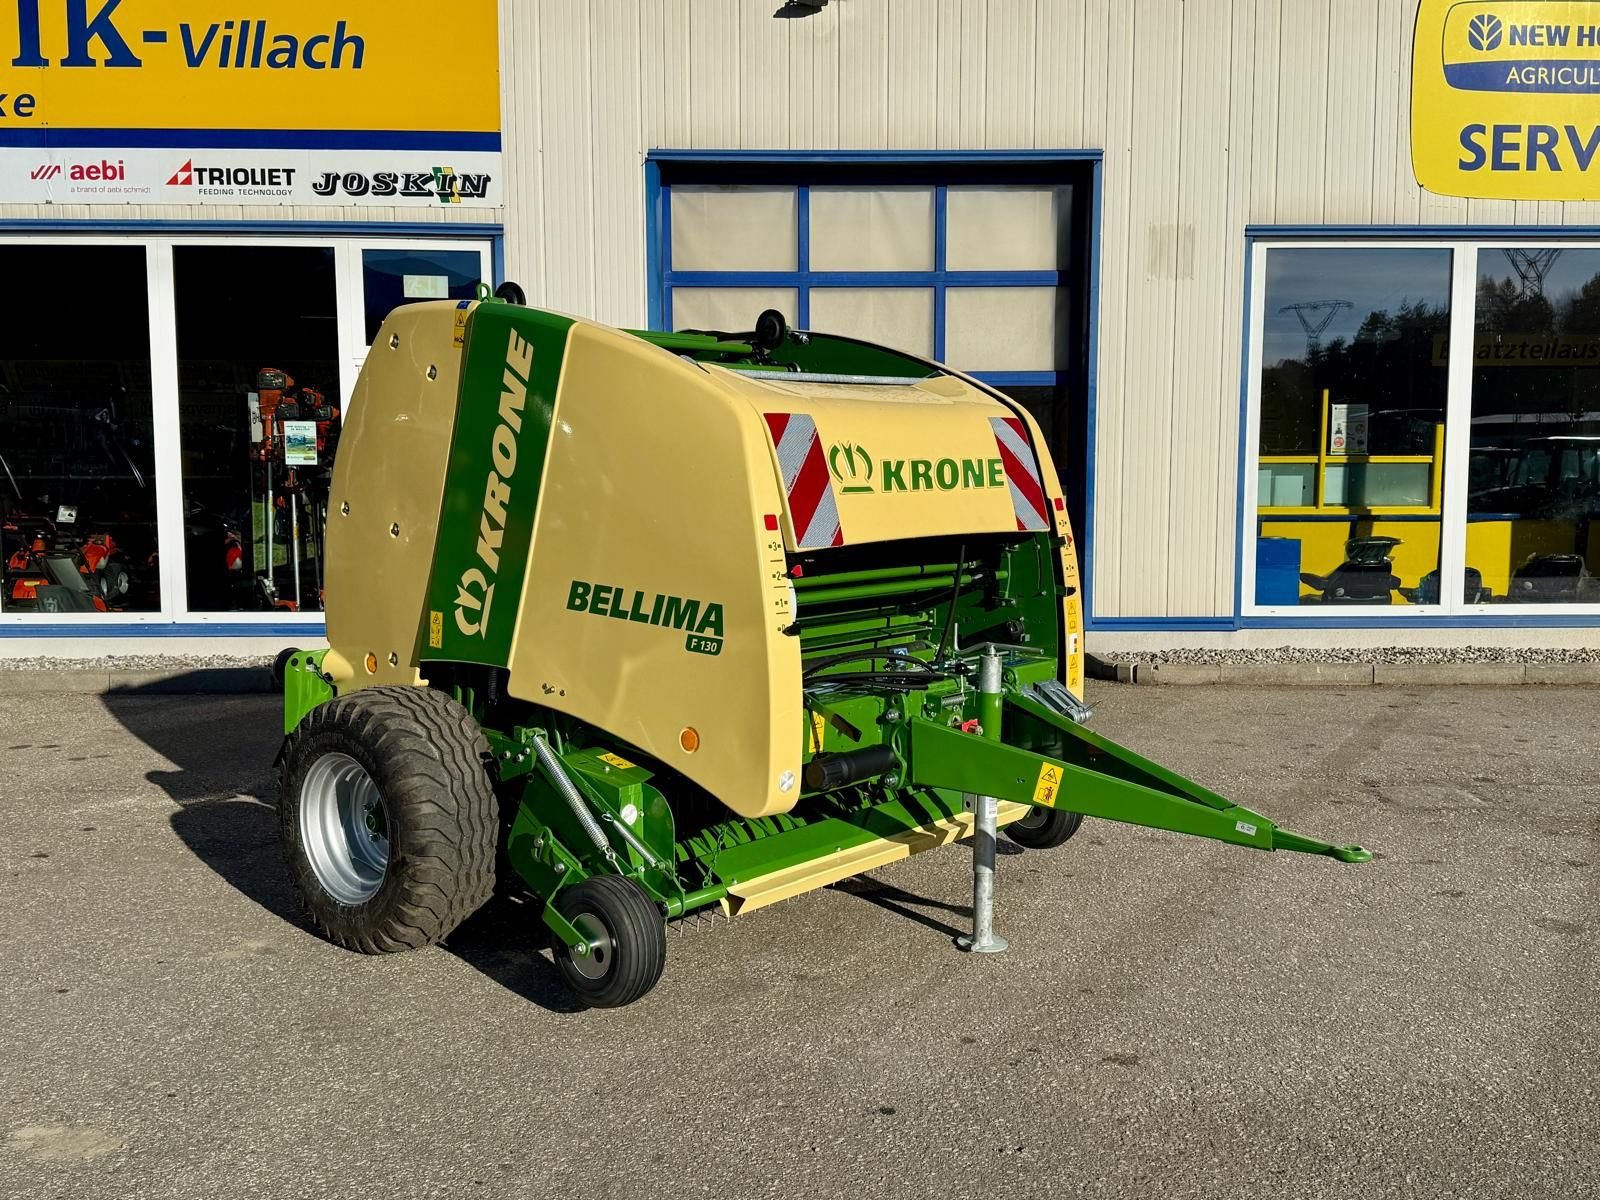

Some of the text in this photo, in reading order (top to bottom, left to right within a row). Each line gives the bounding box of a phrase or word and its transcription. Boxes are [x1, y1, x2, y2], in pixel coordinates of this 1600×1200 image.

[1509, 25, 1600, 46] NEW H
[1506, 66, 1600, 85] AGRICUL
[70, 160, 125, 181] aebi
[193, 168, 296, 186] TRIOLIET
[99, 185, 105, 193] of
[198, 188, 293, 196] FEEDING TECHNOLOGY
[311, 172, 492, 199] JOSKIN
[476, 327, 534, 575] KRONE
[882, 458, 1006, 493] KRONE
[566, 580, 725, 638] BELLIMA
[690, 638, 718, 653] F 130
